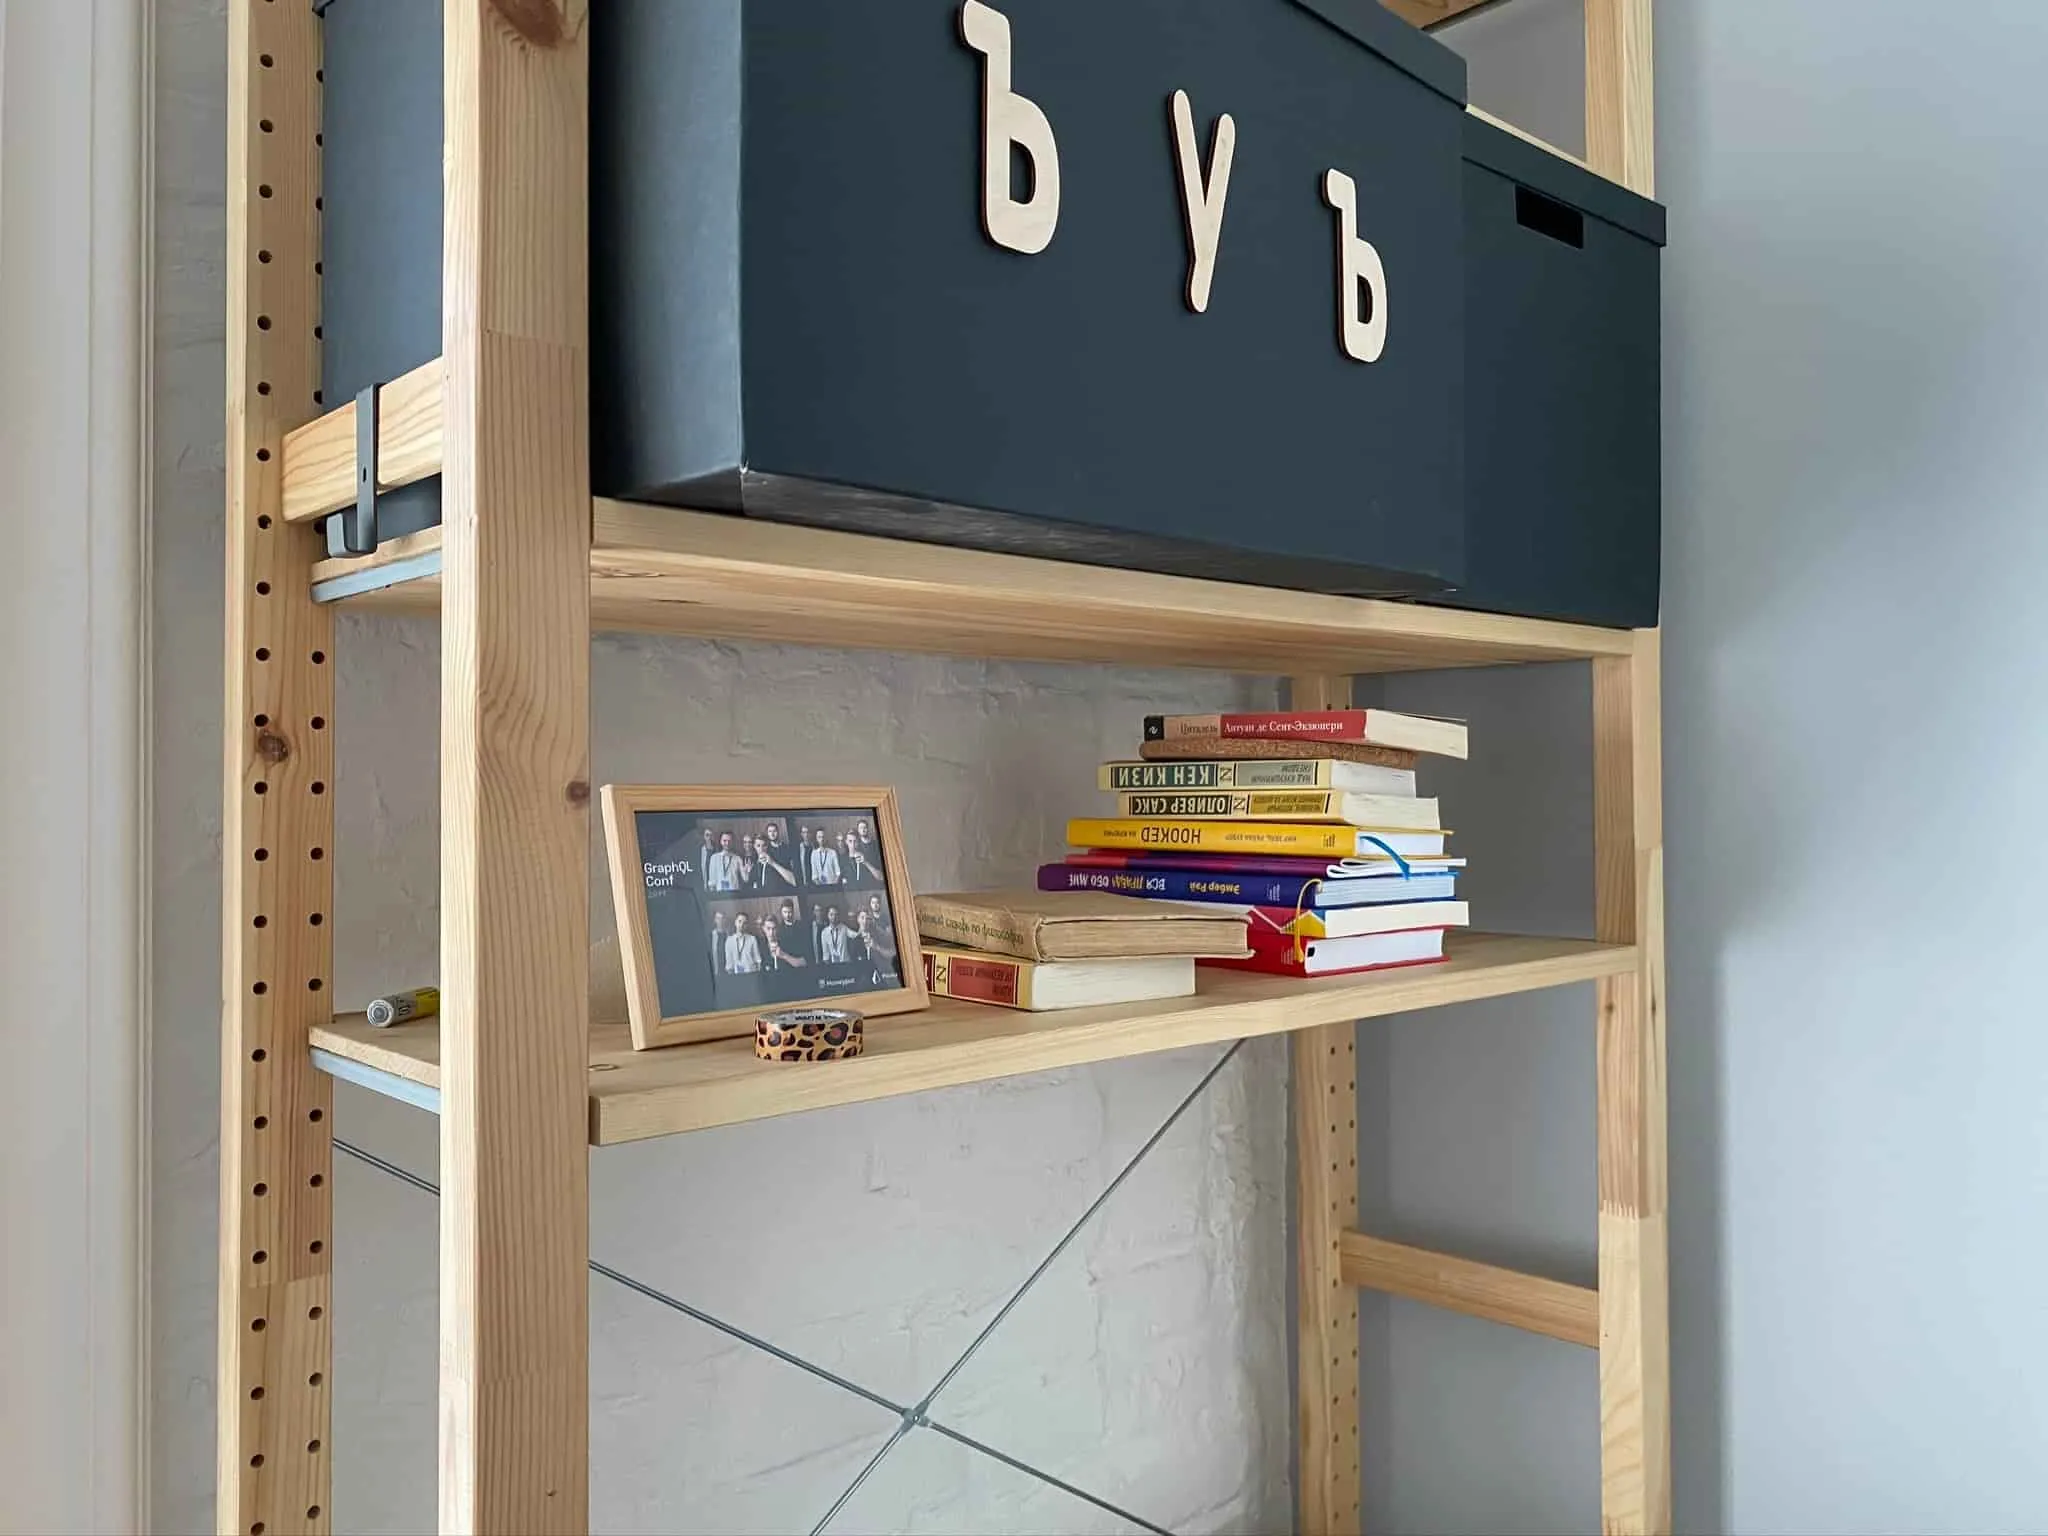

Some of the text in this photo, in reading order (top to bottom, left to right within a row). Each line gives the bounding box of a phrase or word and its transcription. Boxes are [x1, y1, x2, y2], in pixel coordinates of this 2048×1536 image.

[1224, 719, 1344, 734] Антуан де Сент-Экзюпери
[1119, 765, 1209, 786] КЕН КИЗИ
[1134, 796, 1226, 814] ОЛИВЕР САКС
[1141, 826, 1201, 844] HOOKED
[643, 860, 694, 876] GraphQL
[645, 874, 674, 887] Conf
[1069, 873, 1088, 888] МНЕ
[1091, 874, 1109, 888] ОБО
[1146, 877, 1166, 891] ВСЯ
[1189, 880, 1241, 895] Эмбер Рэй
